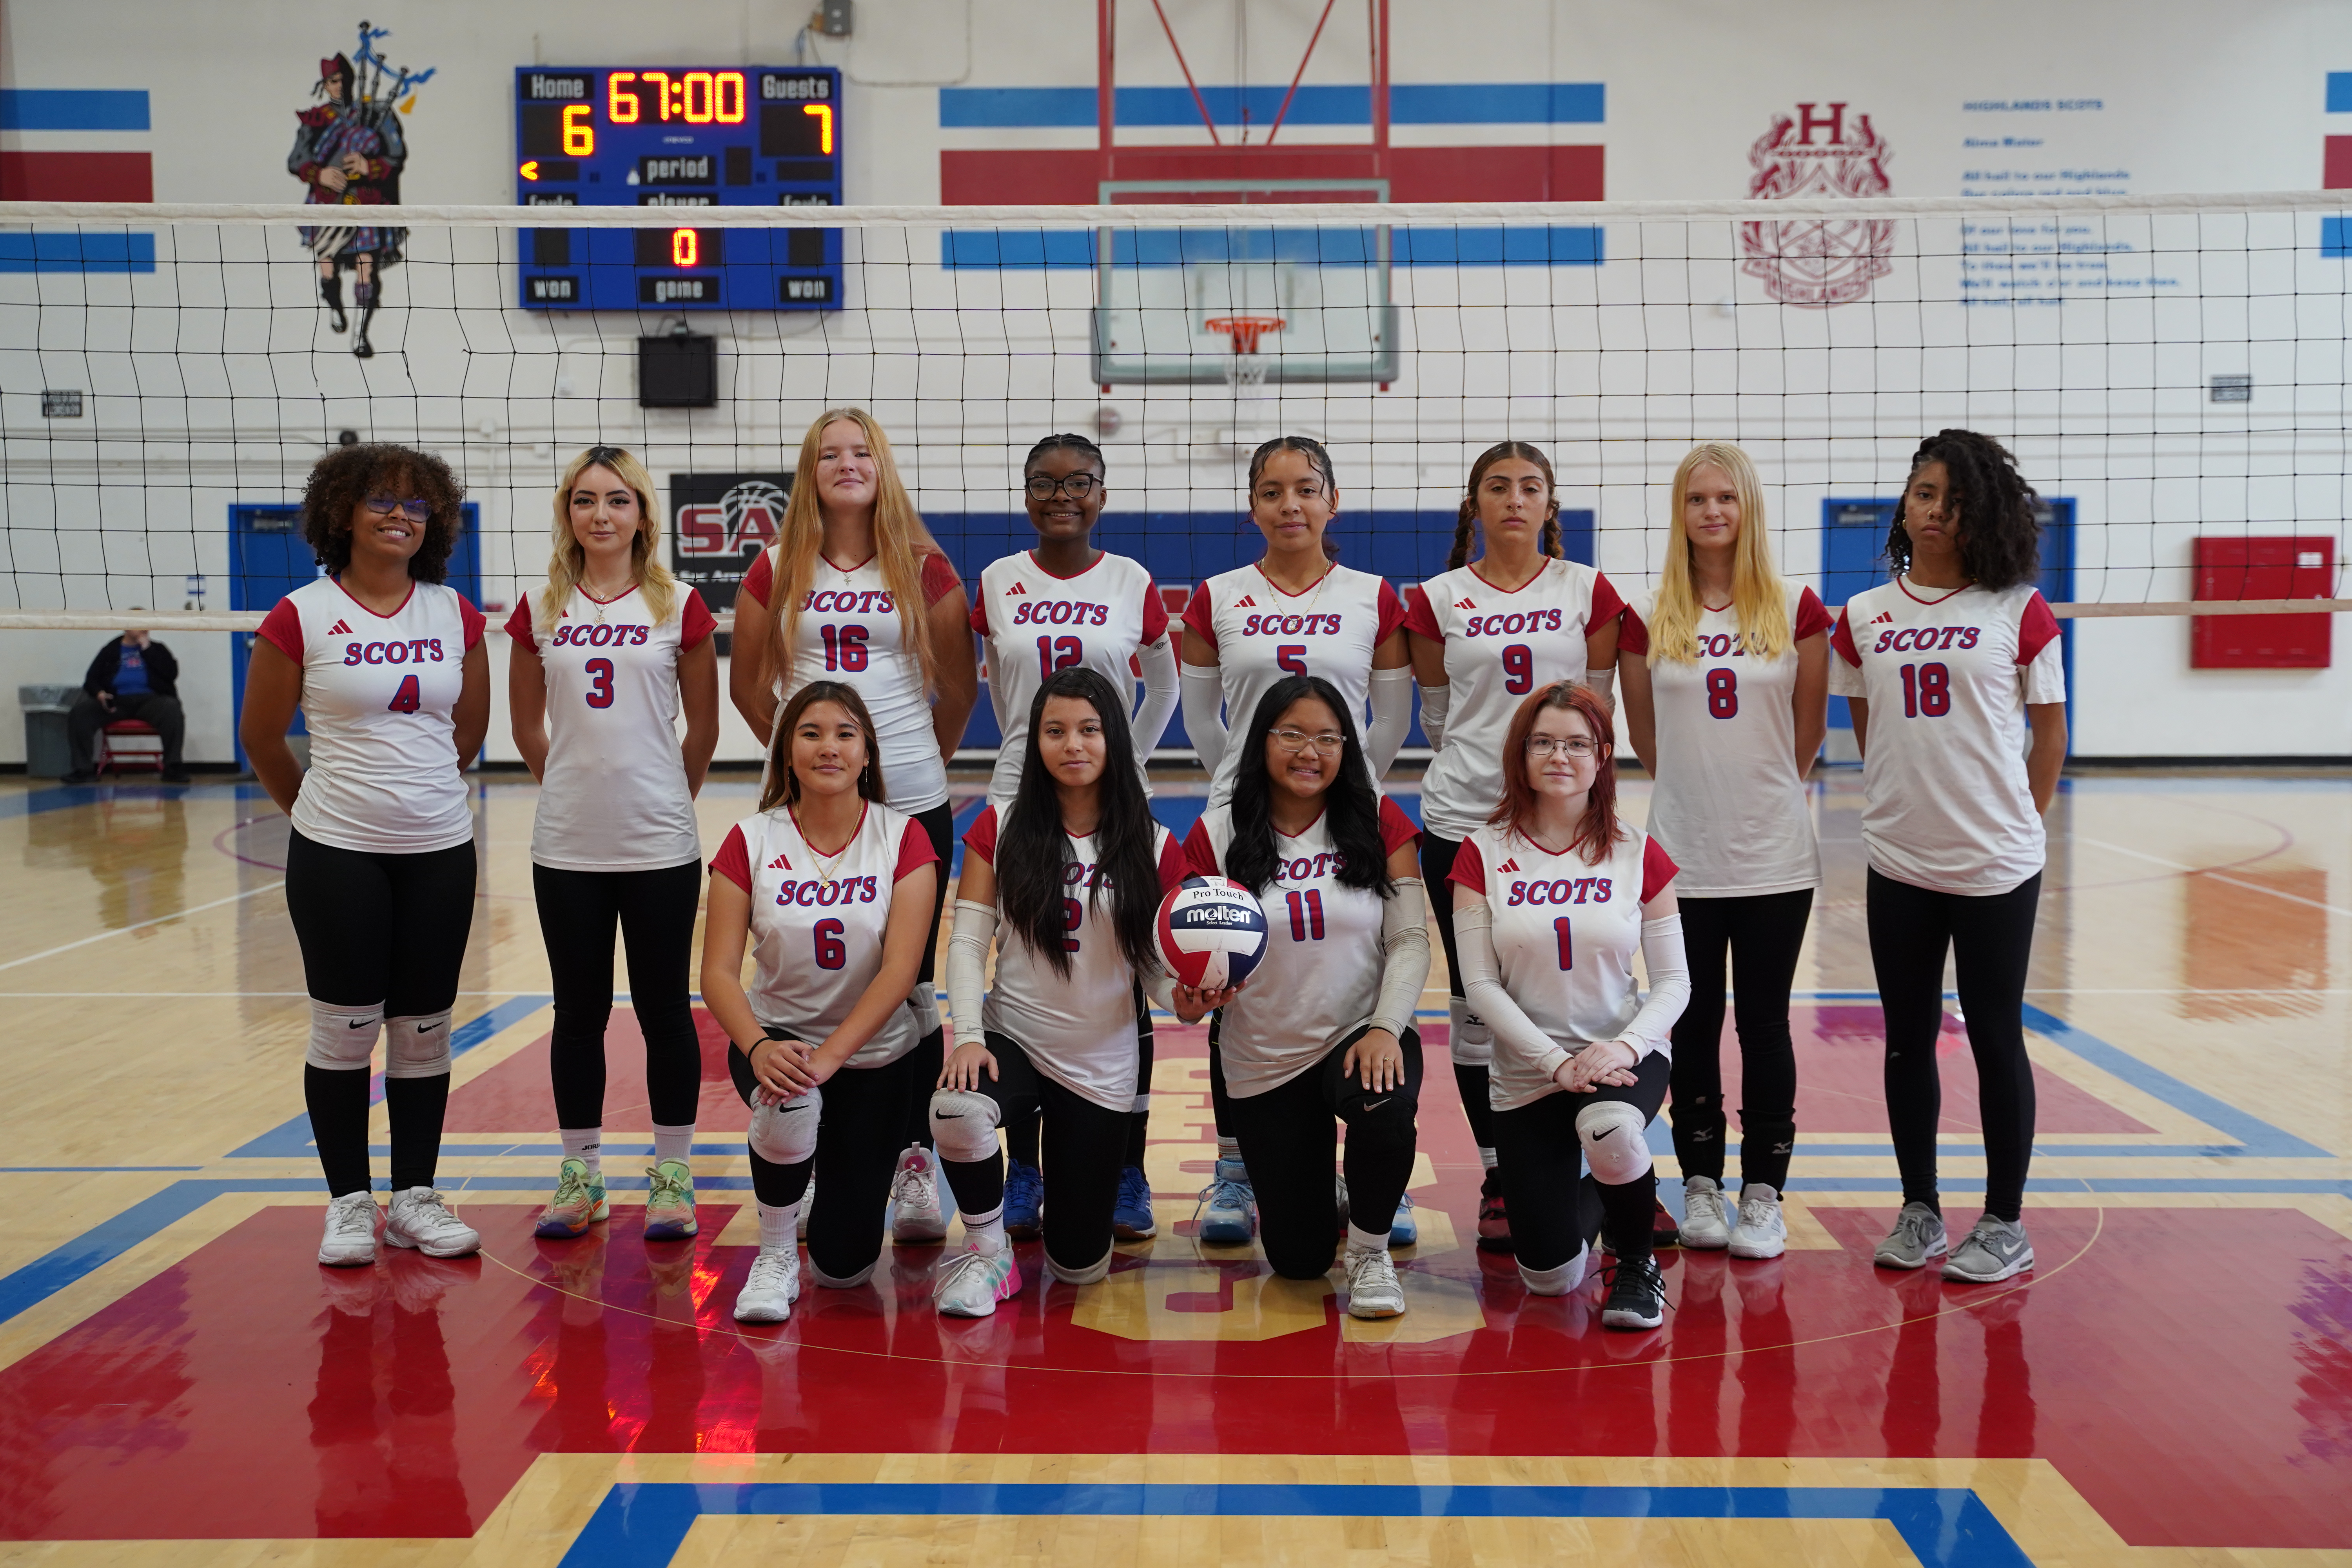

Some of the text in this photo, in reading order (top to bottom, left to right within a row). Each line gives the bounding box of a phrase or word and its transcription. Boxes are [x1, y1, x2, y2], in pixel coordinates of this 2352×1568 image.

[531, 74, 584, 98] Home
[608, 72, 744, 123] 67:00
[762, 75, 829, 98] Guests
[563, 105, 593, 156] 6
[803, 104, 833, 154] 7
[1796, 103, 1847, 144] H
[646, 156, 709, 183] period
[673, 228, 697, 267] 0
[534, 279, 571, 298] won
[655, 280, 703, 303] game
[788, 280, 826, 298] won
[1013, 601, 1109, 626] SCOTS
[1242, 614, 1342, 636] SCOTS
[1465, 608, 1562, 637] SCOTS
[552, 624, 651, 647] SCOTS
[820, 624, 869, 672] 16
[1874, 626, 1981, 653] SCOTS
[344, 638, 444, 666] SCOTS
[1037, 635, 1083, 684] 12
[1277, 645, 1307, 681] 5
[585, 658, 614, 709] 3
[1502, 644, 1534, 695] 9
[388, 674, 421, 715] 4
[1706, 668, 1738, 719] 8
[1900, 662, 1951, 718] 18
[1272, 851, 1348, 881] COTS
[776, 876, 877, 907] SCOTS
[1192, 889, 1244, 901] Pro Touch
[1507, 877, 1613, 906] SCOTS
[1187, 906, 1250, 924] molten
[1285, 889, 1325, 942] 11
[813, 918, 846, 970] 6
[1553, 916, 1573, 971] 1
